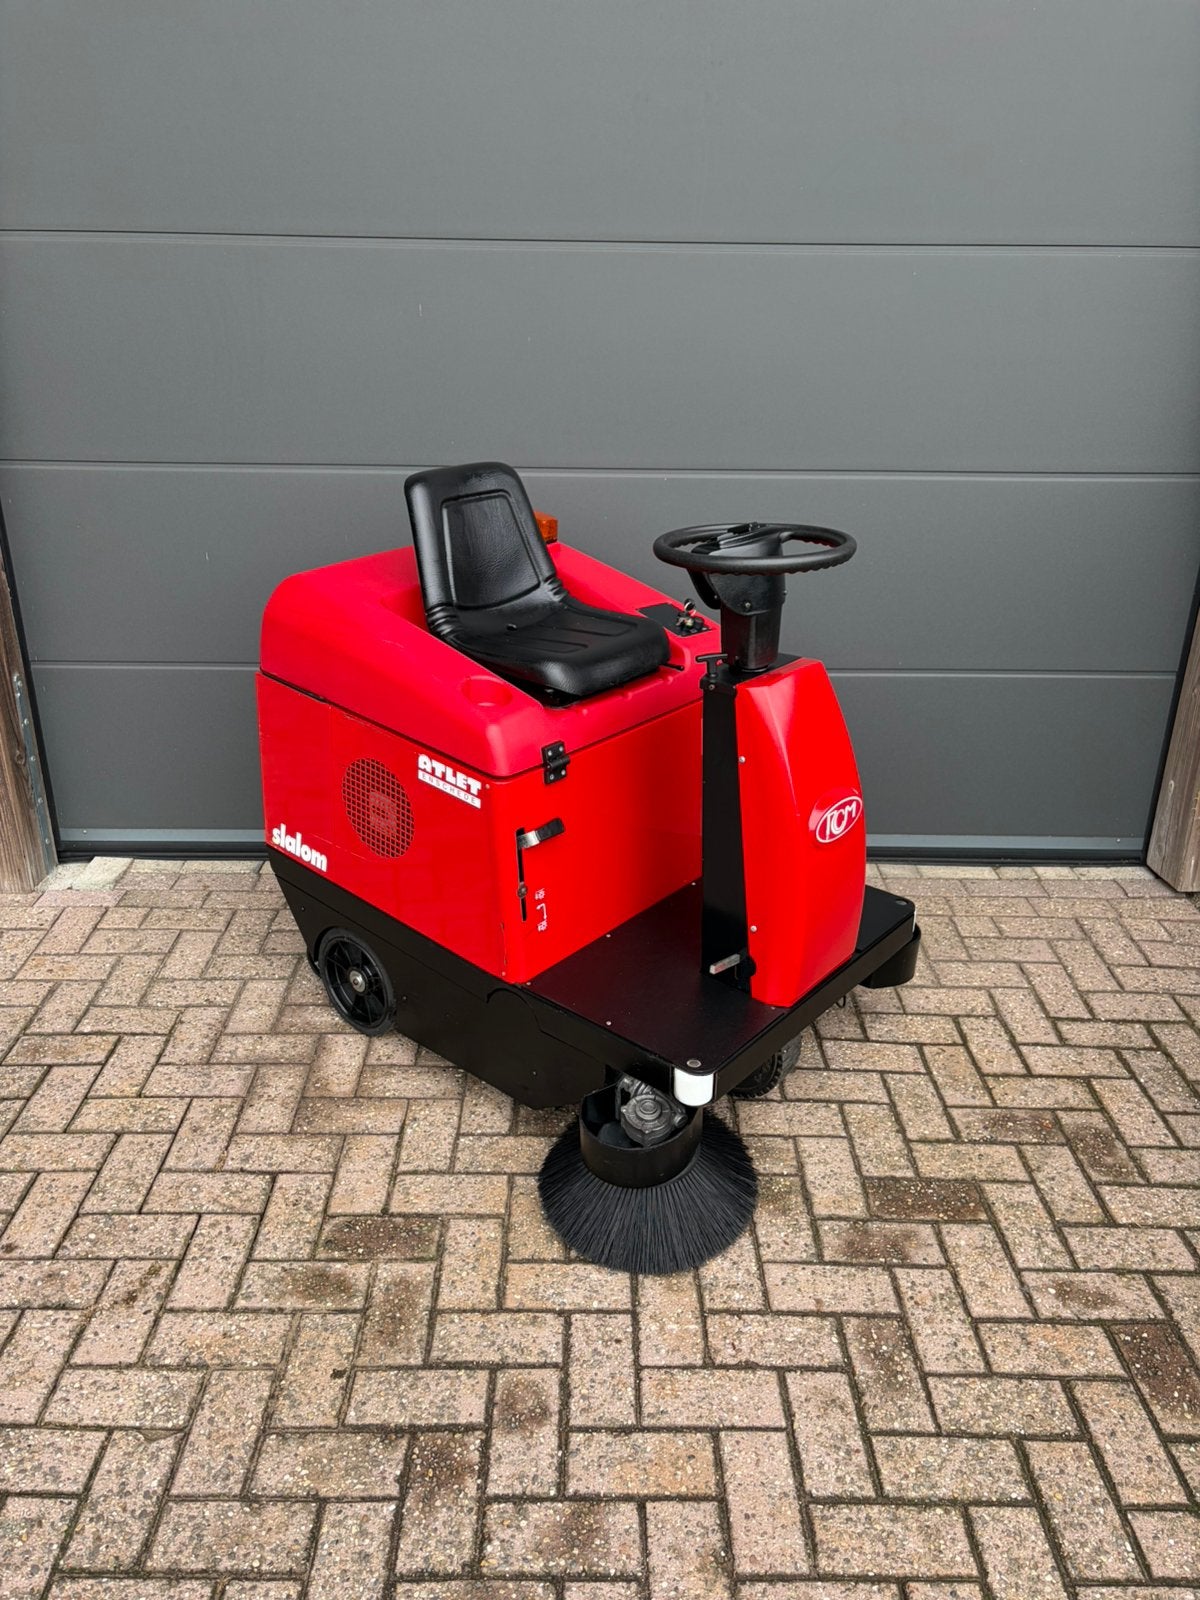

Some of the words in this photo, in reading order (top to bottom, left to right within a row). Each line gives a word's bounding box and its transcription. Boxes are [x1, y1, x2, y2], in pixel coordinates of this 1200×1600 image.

[418, 753, 481, 796] ATLET
[421, 772, 477, 805] ENSCHEDE
[272, 822, 328, 872] slalom
